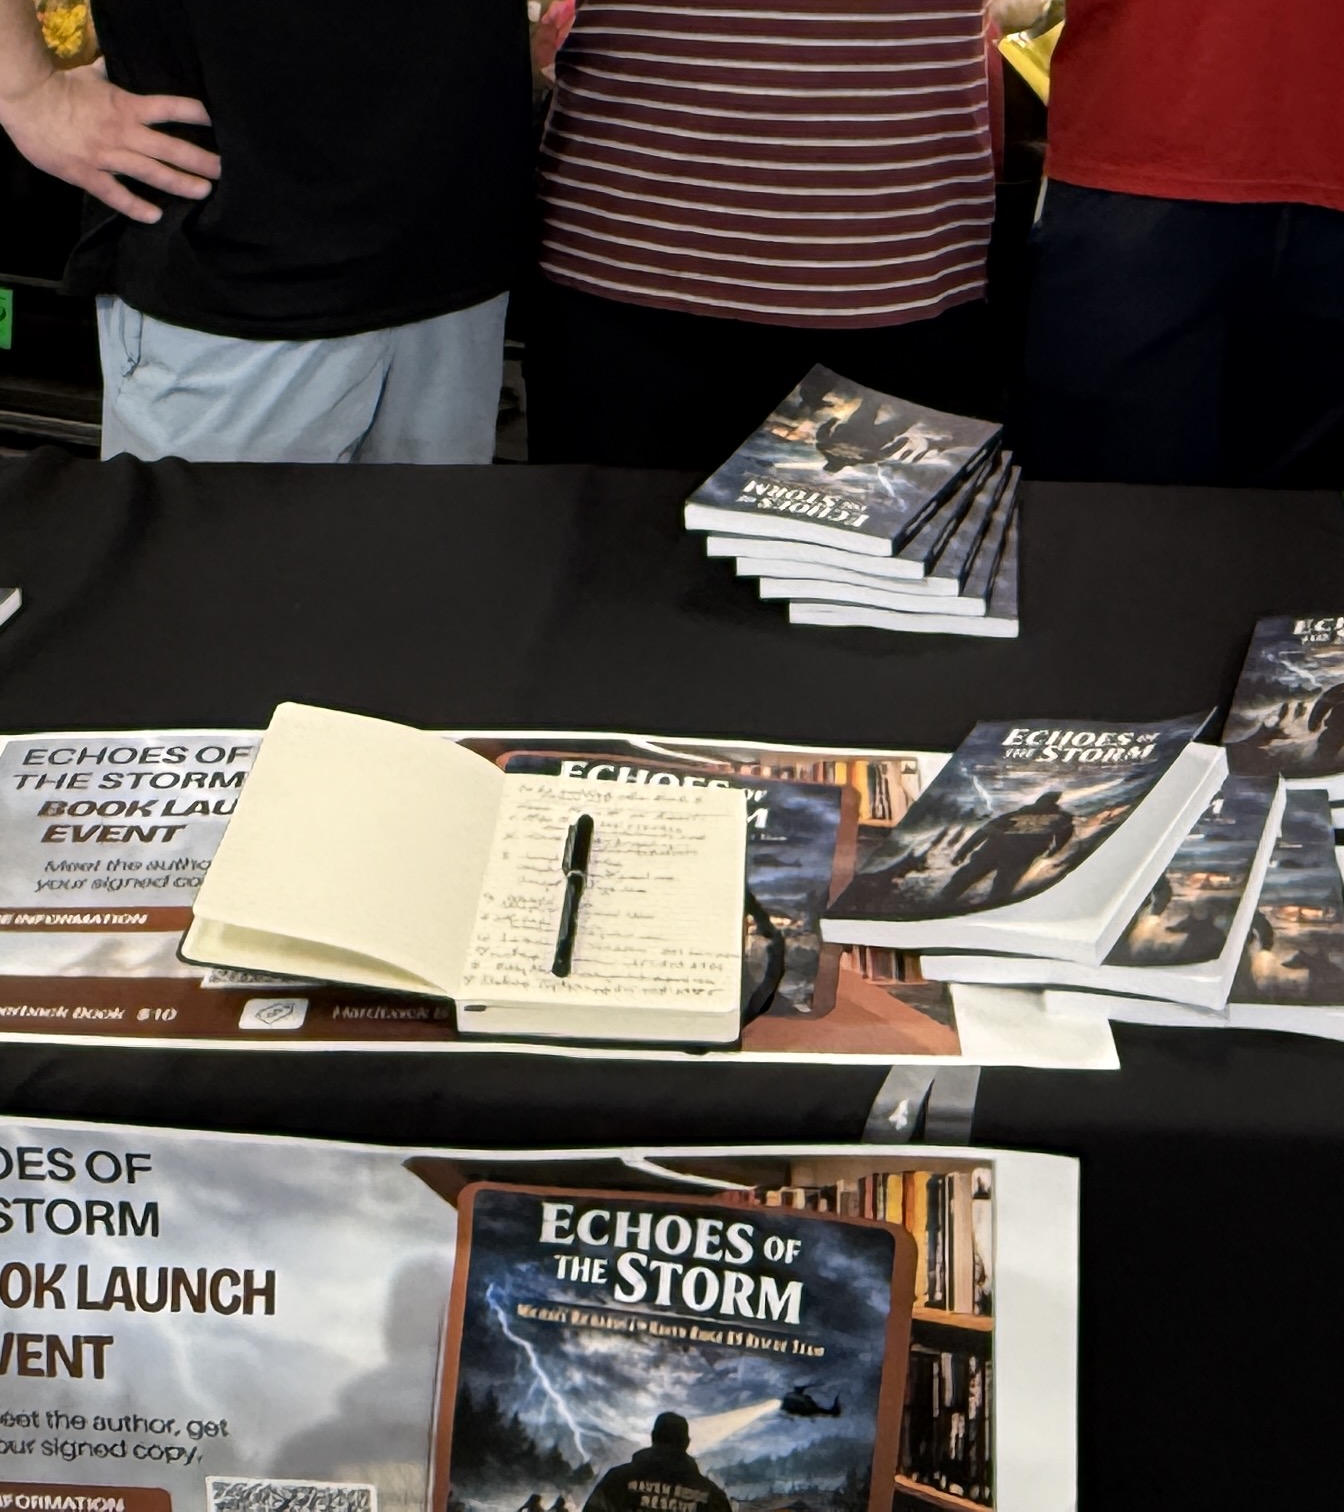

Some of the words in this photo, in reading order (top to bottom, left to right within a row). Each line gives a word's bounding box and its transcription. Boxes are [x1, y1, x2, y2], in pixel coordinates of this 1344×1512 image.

[1002, 728, 1136, 748] ECHOES
[22, 745, 189, 767] ECHOES
[195, 745, 253, 765] OF
[1036, 743, 1158, 763] STORM
[13, 772, 91, 791] THE
[97, 771, 248, 790] STORM
[37, 799, 155, 818] BOOK
[160, 798, 239, 817] LAU
[40, 824, 188, 844] EVENT
[146, 857, 212, 872] autho
[85, 1150, 153, 1185] OF
[539, 1201, 755, 1266] ECHOES
[762, 1235, 803, 1265] OF
[76, 1264, 277, 1316] LAUNCH
[553, 1254, 609, 1285] THE
[613, 1251, 804, 1325] STORM
[45, 1409, 86, 1431] the
[91, 1412, 182, 1438] author,
[186, 1417, 228, 1439] get
[40, 1436, 127, 1461] signed
